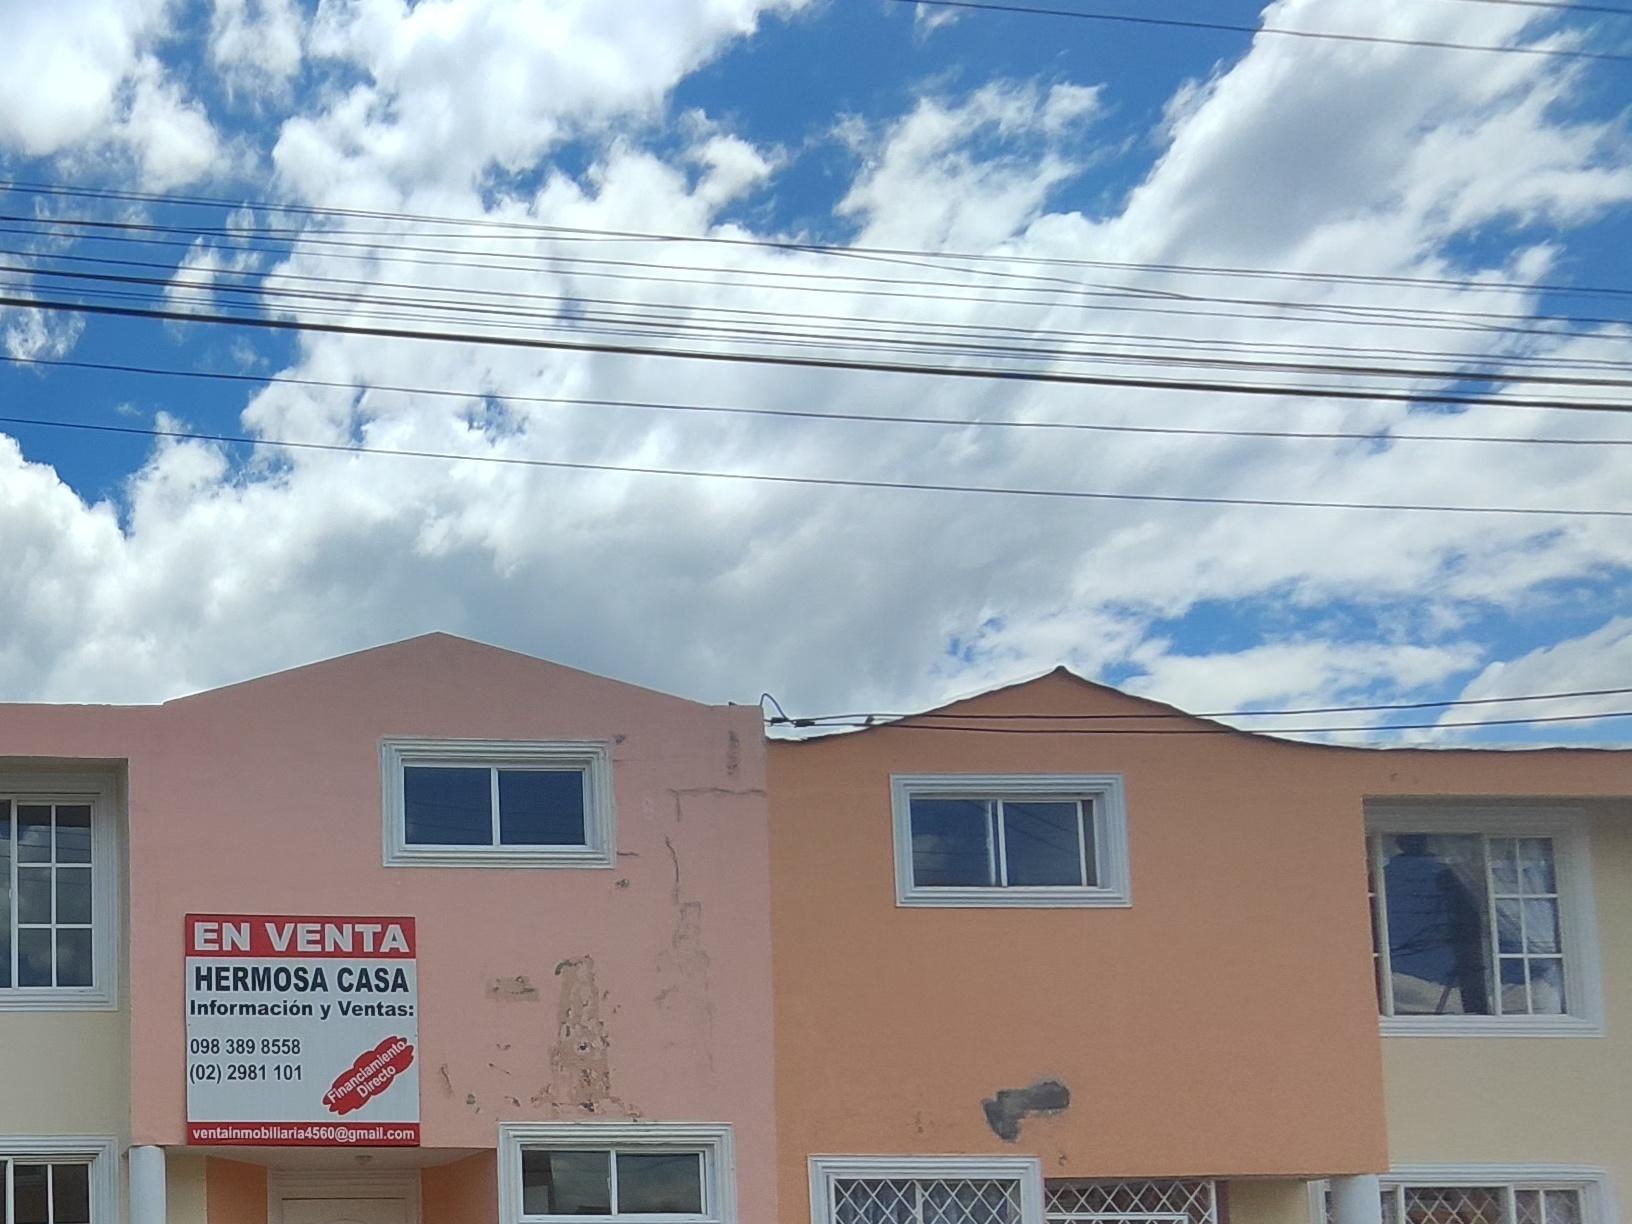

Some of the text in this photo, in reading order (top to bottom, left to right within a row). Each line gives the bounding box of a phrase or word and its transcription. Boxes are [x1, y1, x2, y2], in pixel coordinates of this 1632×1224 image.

[194, 922, 409, 953] EN VENTA
[195, 966, 409, 993] HERMOSA CASA
[190, 1000, 414, 1020] Información y Ventas:
[190, 1039, 301, 1055] 098 389 8558
[190, 1064, 302, 1084] (02) 2981 101
[328, 1040, 405, 1103] Financiamiento
[357, 1065, 396, 1098] Directo
[193, 1127, 415, 1140] ventainmobiliaria4560@gmail.com
